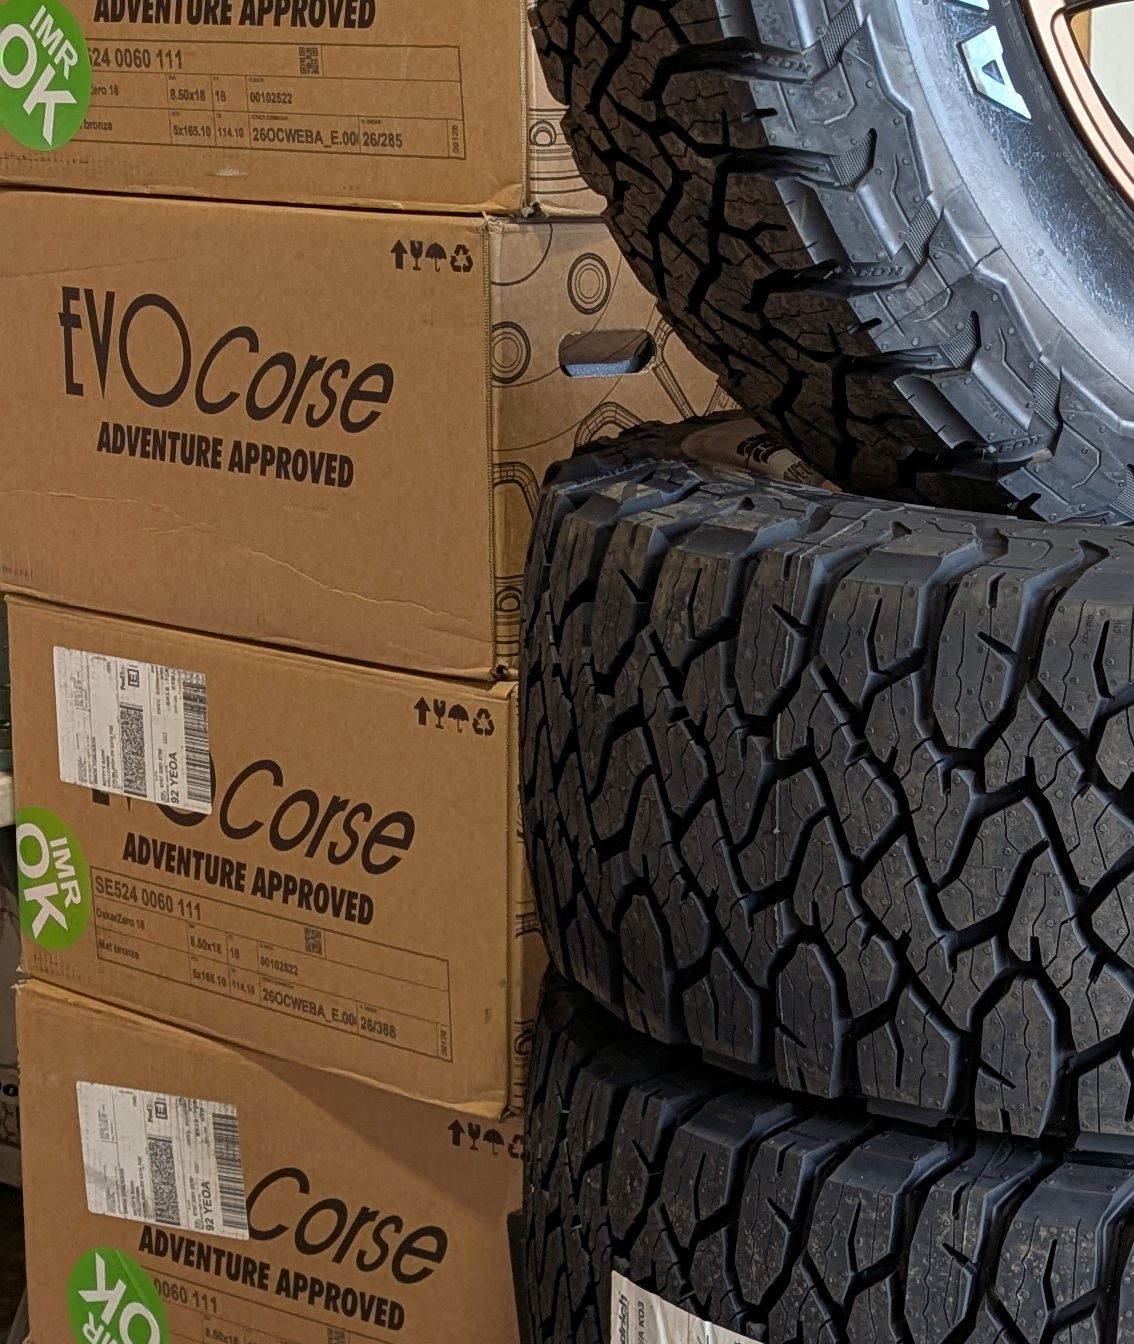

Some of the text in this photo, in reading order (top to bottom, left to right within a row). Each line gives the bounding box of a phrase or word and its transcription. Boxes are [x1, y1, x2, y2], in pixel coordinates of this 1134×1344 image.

[29, 5, 78, 81] IMR
[115, 48, 151, 68] 0060
[156, 49, 182, 69] 111
[0, 23, 77, 146] OK
[109, 85, 119, 96] 18
[170, 88, 206, 102] 8.50x18
[215, 90, 226, 102] 18
[173, 125, 211, 137] 5x165.10
[217, 127, 244, 138] 114.10
[252, 127, 359, 148] 26OCWEBA_E.00
[362, 132, 403, 148] 26/285
[58, 285, 394, 434] EVOCorse
[97, 421, 354, 488] ADVENTURE APPROVED
[169, 752, 180, 804] 92 YEOA
[16, 822, 69, 940] OK
[49, 836, 83, 909] IMR
[123, 832, 374, 926] ADVENTURE APPROVED
[95, 875, 201, 921] SE524 0060 111
[230, 947, 240, 960] 18
[262, 987, 357, 1027] 26OCWEBA_E.00
[138, 1225, 405, 1332] ADVENTURE APPROVED
[192, 1291, 218, 1314] 111
